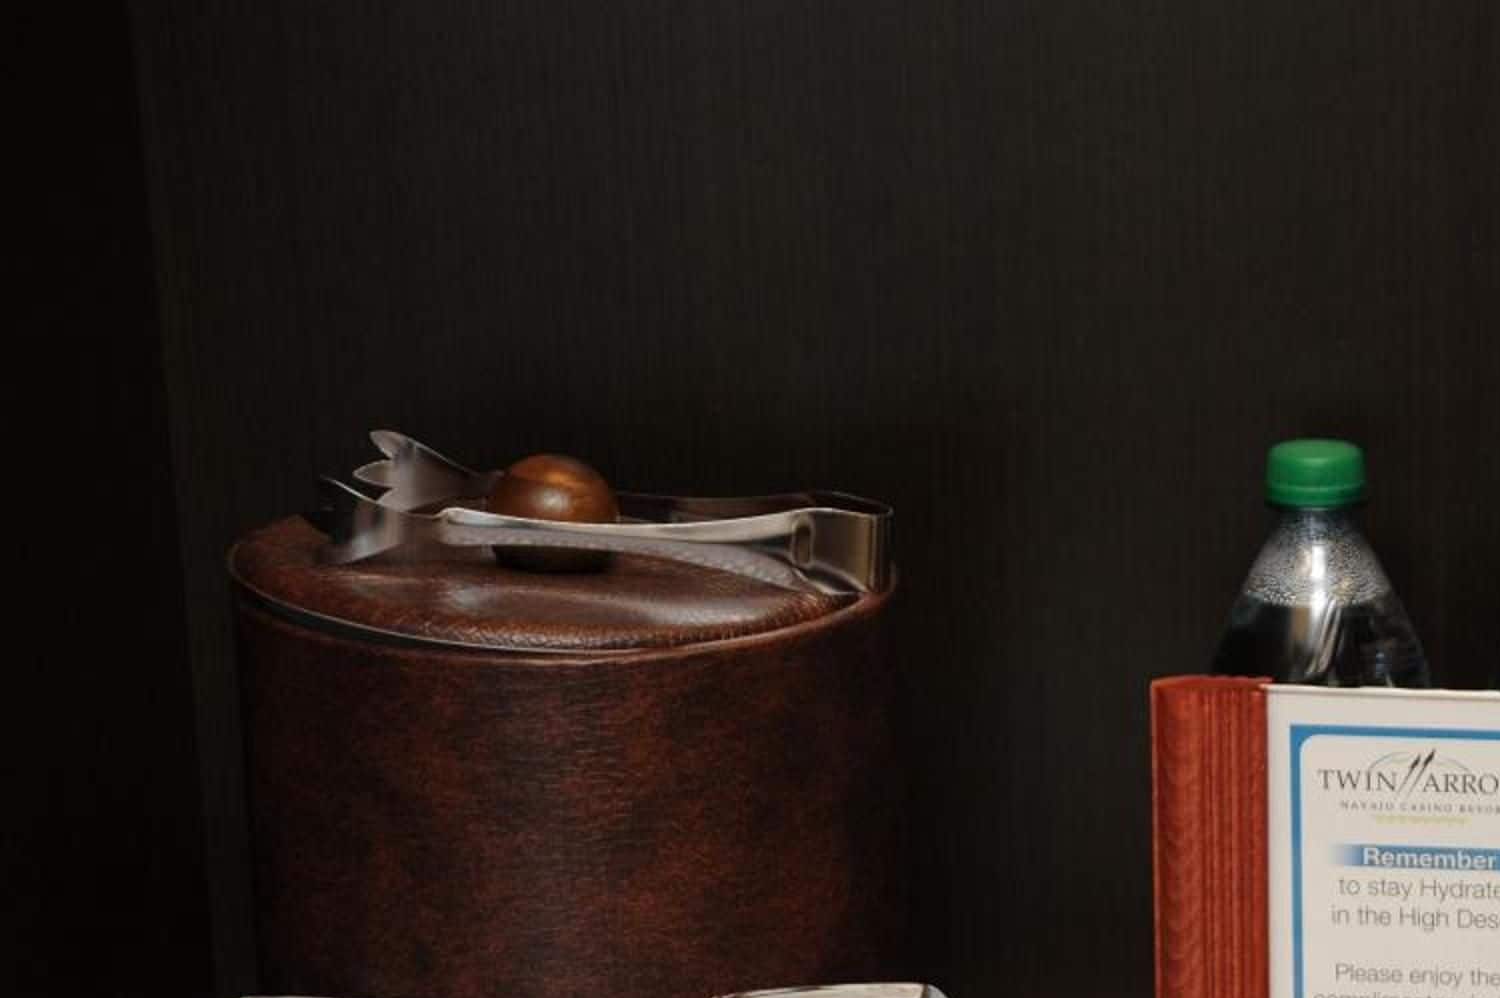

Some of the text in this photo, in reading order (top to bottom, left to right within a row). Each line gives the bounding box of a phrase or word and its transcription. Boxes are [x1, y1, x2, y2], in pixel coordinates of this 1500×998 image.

[1318, 768, 1397, 792] TWIN
[1363, 847, 1497, 870] Remember
[1338, 879, 1361, 896] to
[1367, 879, 1413, 901] stay
[1331, 904, 1350, 925] in
[1357, 905, 1392, 927] the
[1400, 907, 1450, 932] High
[1335, 963, 1403, 984] Please
[1409, 967, 1463, 989] enjoy
